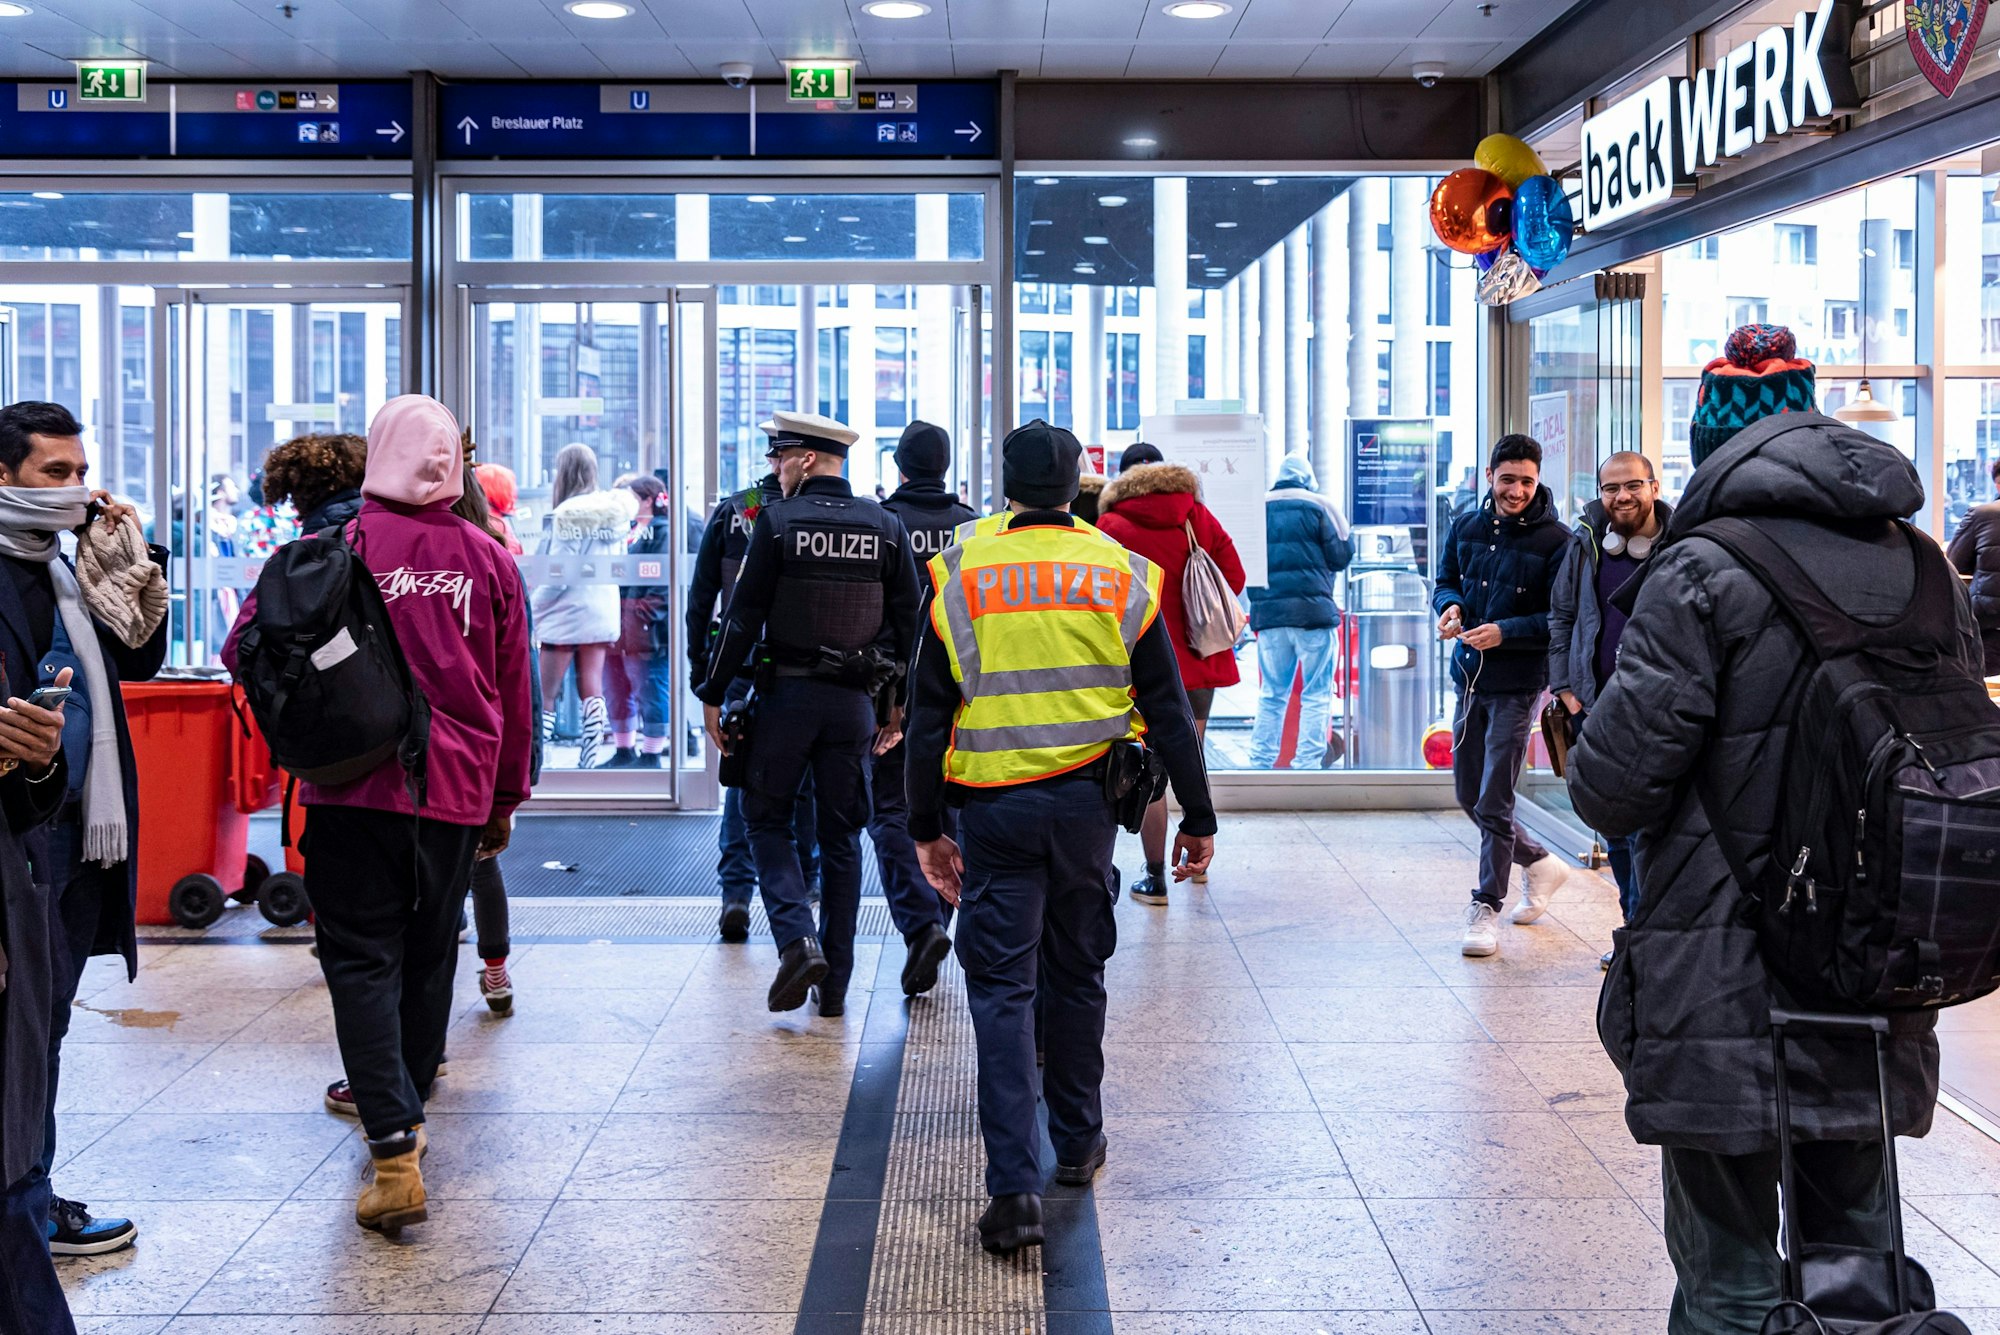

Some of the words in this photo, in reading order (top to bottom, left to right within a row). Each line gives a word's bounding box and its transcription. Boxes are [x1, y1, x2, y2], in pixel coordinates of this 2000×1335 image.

[51, 90, 65, 108] U
[633, 91, 647, 109] U
[1587, 97, 1666, 219] back
[1679, 0, 1835, 176] WERK
[491, 115, 550, 129] Breslauer
[552, 115, 583, 129] Platz
[796, 531, 879, 560] POLIZEI
